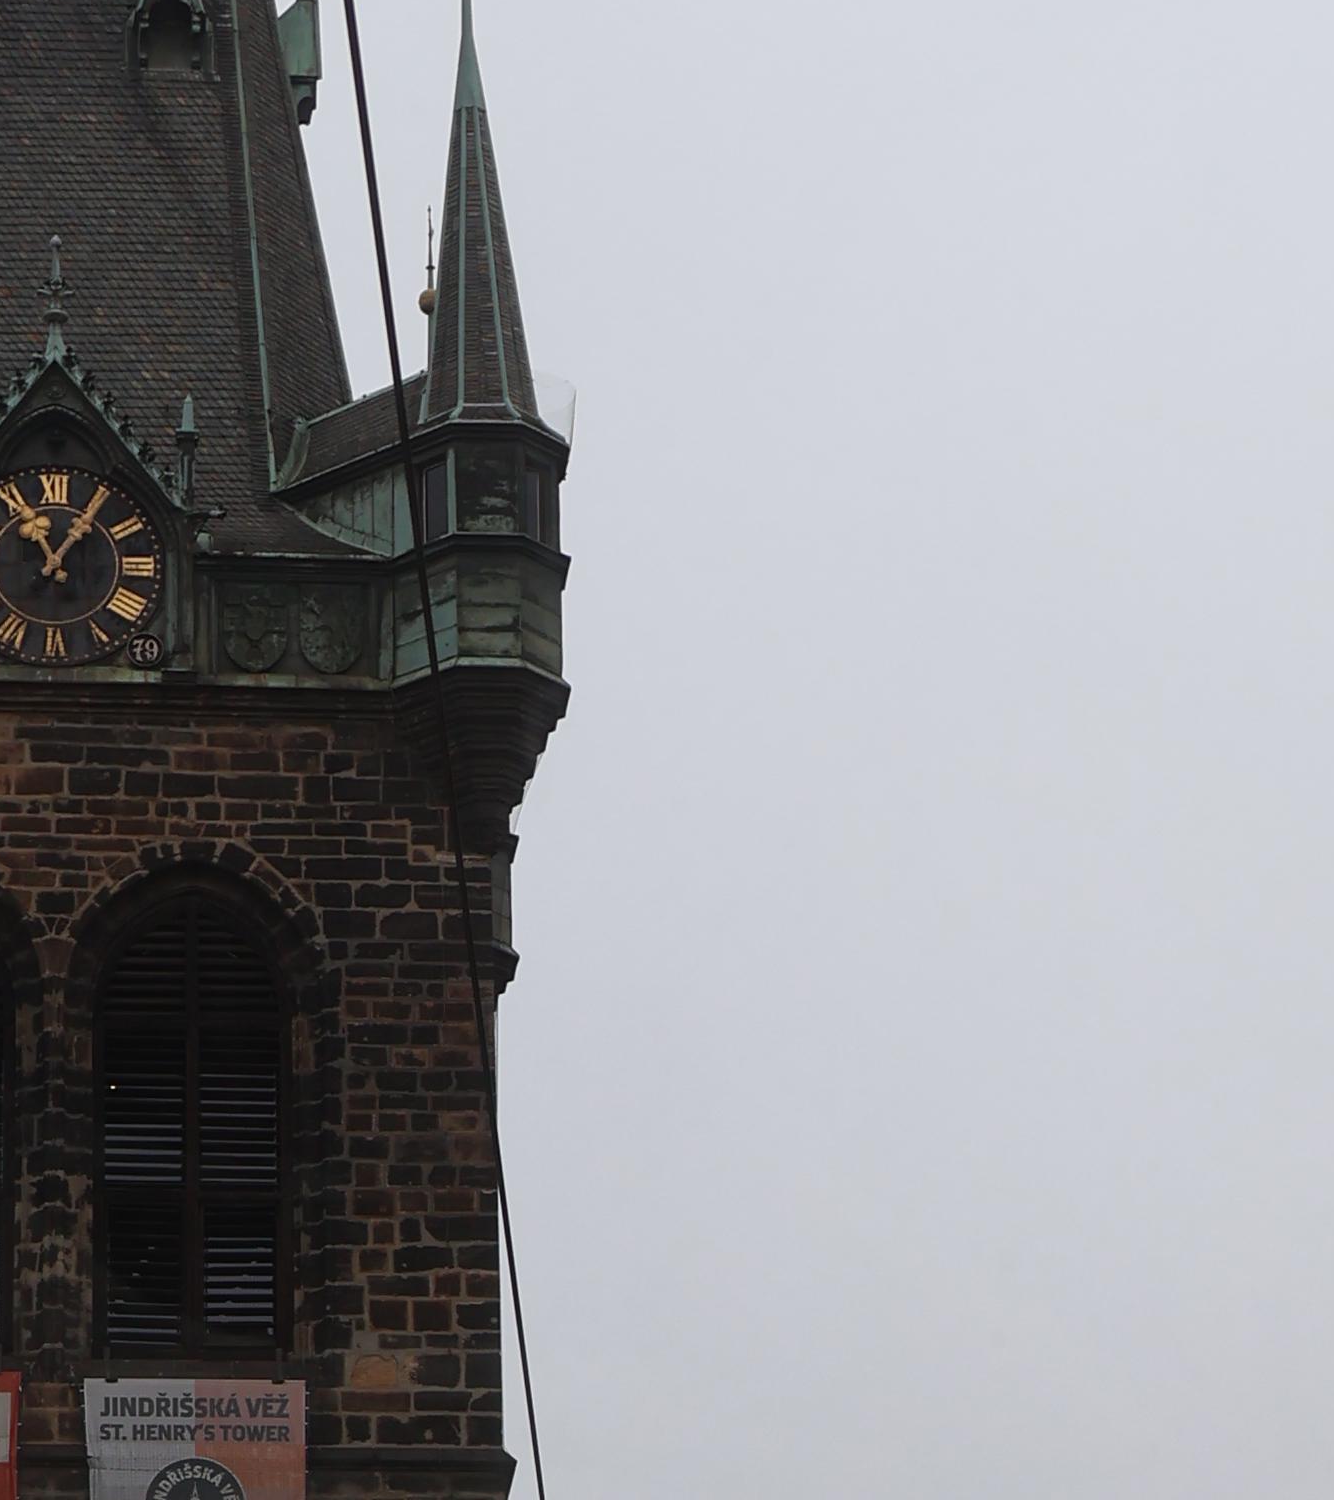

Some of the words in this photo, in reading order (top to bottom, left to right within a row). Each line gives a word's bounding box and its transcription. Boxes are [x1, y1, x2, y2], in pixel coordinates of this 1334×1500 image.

[38, 473, 70, 505] XII
[109, 515, 145, 541] II
[121, 555, 155, 577] III
[43, 627, 68, 657] VI
[100, 1392, 241, 1418] JINDŘIŠSKÁ
[246, 1393, 290, 1419] VĚŽ
[99, 1423, 127, 1441] ST.
[132, 1423, 216, 1442] HENRY'S
[220, 1424, 290, 1442] TOWER
